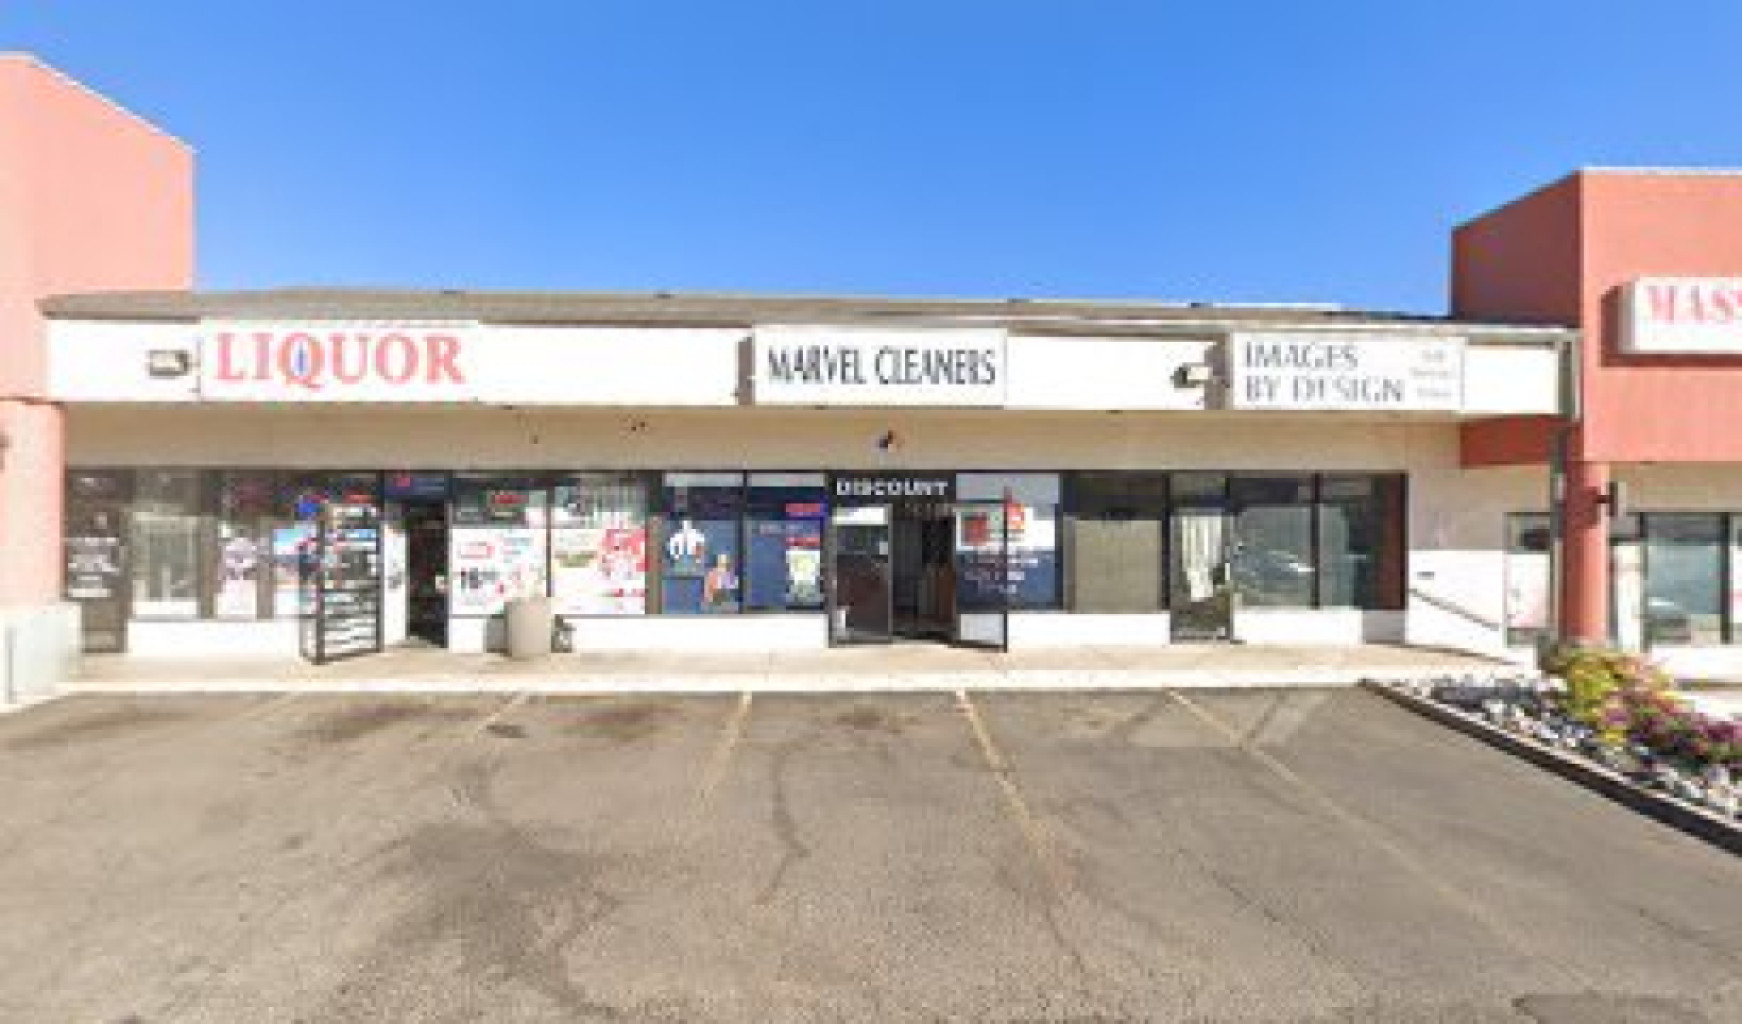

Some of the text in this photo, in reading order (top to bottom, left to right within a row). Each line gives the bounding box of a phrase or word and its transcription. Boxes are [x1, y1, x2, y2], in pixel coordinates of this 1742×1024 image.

[214, 332, 466, 392] LIQUOR
[768, 345, 996, 385] MARVEL CLEANERS
[1245, 341, 1358, 369] IMAGES
[1245, 375, 1281, 402] BY
[1292, 376, 1406, 402] DESIGN
[836, 478, 949, 496] DISCOUNT
